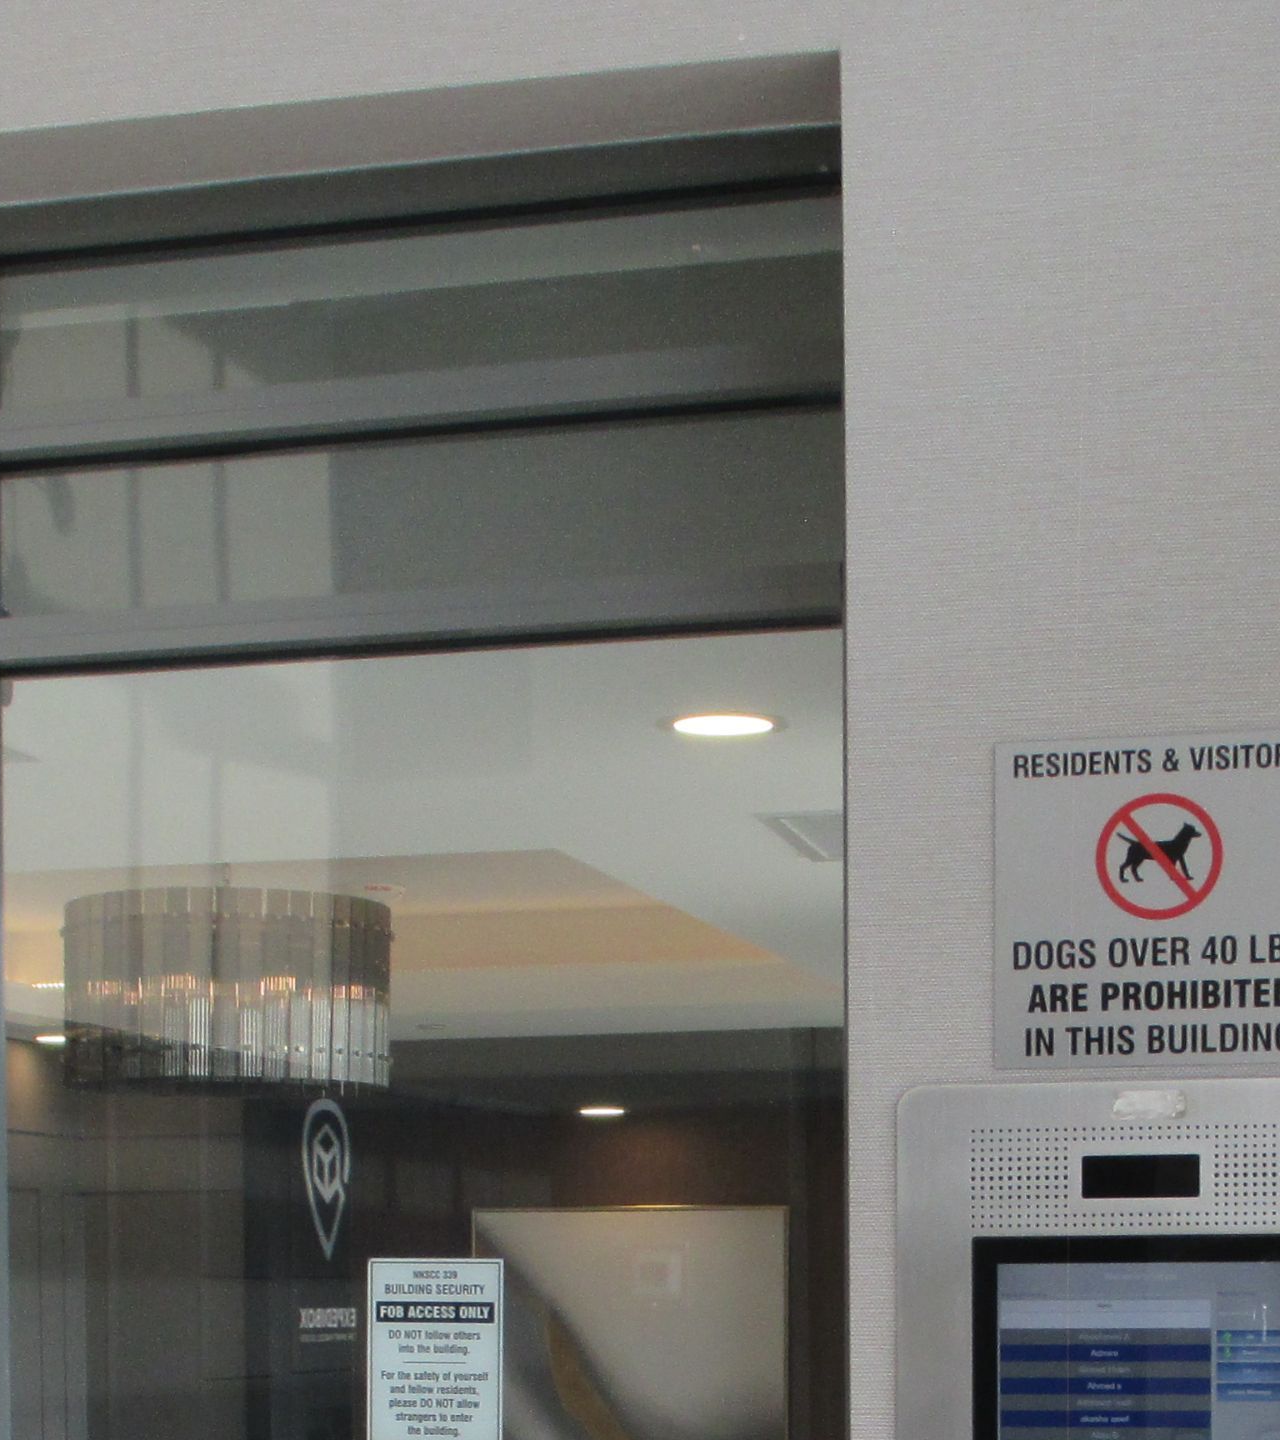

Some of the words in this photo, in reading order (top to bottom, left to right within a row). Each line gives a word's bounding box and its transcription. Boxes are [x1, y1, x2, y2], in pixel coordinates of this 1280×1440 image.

[1013, 749, 1152, 778] RESIDENTS
[1162, 748, 1179, 772] &
[1012, 939, 1097, 970] DOGS
[1108, 936, 1190, 968] OVER
[1201, 935, 1238, 965] 40
[1028, 983, 1088, 1013] ARE
[1026, 1028, 1055, 1057] IN
[1065, 1025, 1135, 1055] THIS
[385, 1284, 432, 1294] BUILDING
[436, 1284, 485, 1295] SECURITY
[380, 1306, 404, 1318] FOB
[408, 1306, 455, 1319] ACCESS
[460, 1307, 490, 1319] ONLY
[389, 1330, 401, 1339] DO
[404, 1330, 422, 1339] NOT
[425, 1330, 451, 1340] follow
[453, 1331, 481, 1340] others
[399, 1344, 415, 1353] into
[418, 1344, 430, 1353] the
[434, 1344, 470, 1356] building.
[381, 1370, 394, 1380] For
[398, 1371, 411, 1380] the
[414, 1371, 439, 1382] safety
[443, 1372, 451, 1380] of
[454, 1372, 489, 1382] yourself
[390, 1385, 405, 1394] and
[408, 1385, 433, 1394] fellow
[389, 1399, 417, 1409] please
[420, 1399, 433, 1408] DO
[436, 1399, 454, 1408] NOT
[457, 1400, 480, 1408] allow
[396, 1412, 437, 1423] strangers
[440, 1413, 448, 1421] to
[450, 1414, 473, 1422] enter
[408, 1426, 421, 1435] the
